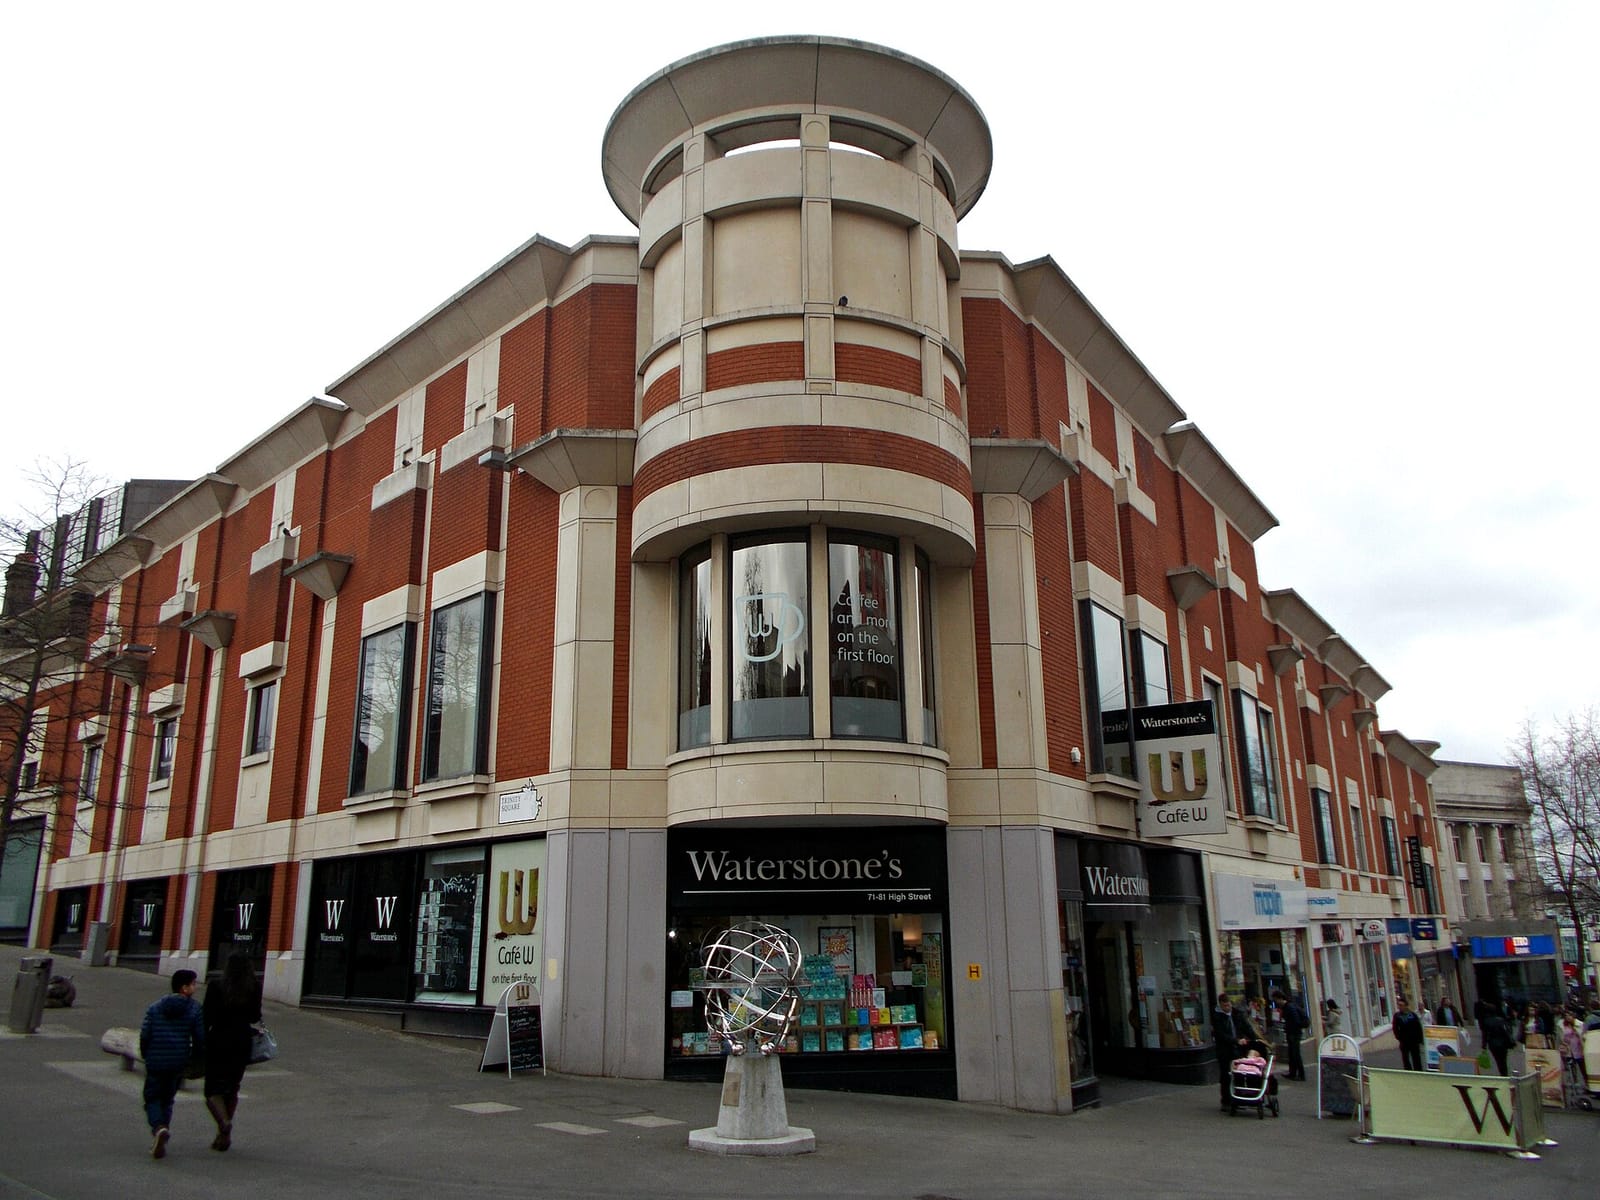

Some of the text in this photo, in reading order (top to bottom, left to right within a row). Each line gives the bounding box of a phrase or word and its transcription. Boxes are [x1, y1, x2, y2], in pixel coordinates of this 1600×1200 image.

[837, 592, 879, 609] Cofee
[837, 614, 857, 625] an
[837, 631, 879, 645] on the
[837, 647, 894, 665] first floor
[1141, 713, 1207, 729] Waterstone's
[502, 803, 521, 812] SQUARE
[1157, 807, 1208, 824] Café W
[686, 849, 903, 881] Waterstone's
[867, 892, 932, 902] 71-81 High Street
[143, 903, 155, 927] W
[239, 903, 254, 930] W
[326, 900, 345, 929] W
[376, 896, 398, 928] W
[498, 945, 534, 965] Café W
[492, 972, 537, 984] on the first floor
[1452, 1085, 1516, 1137] W
